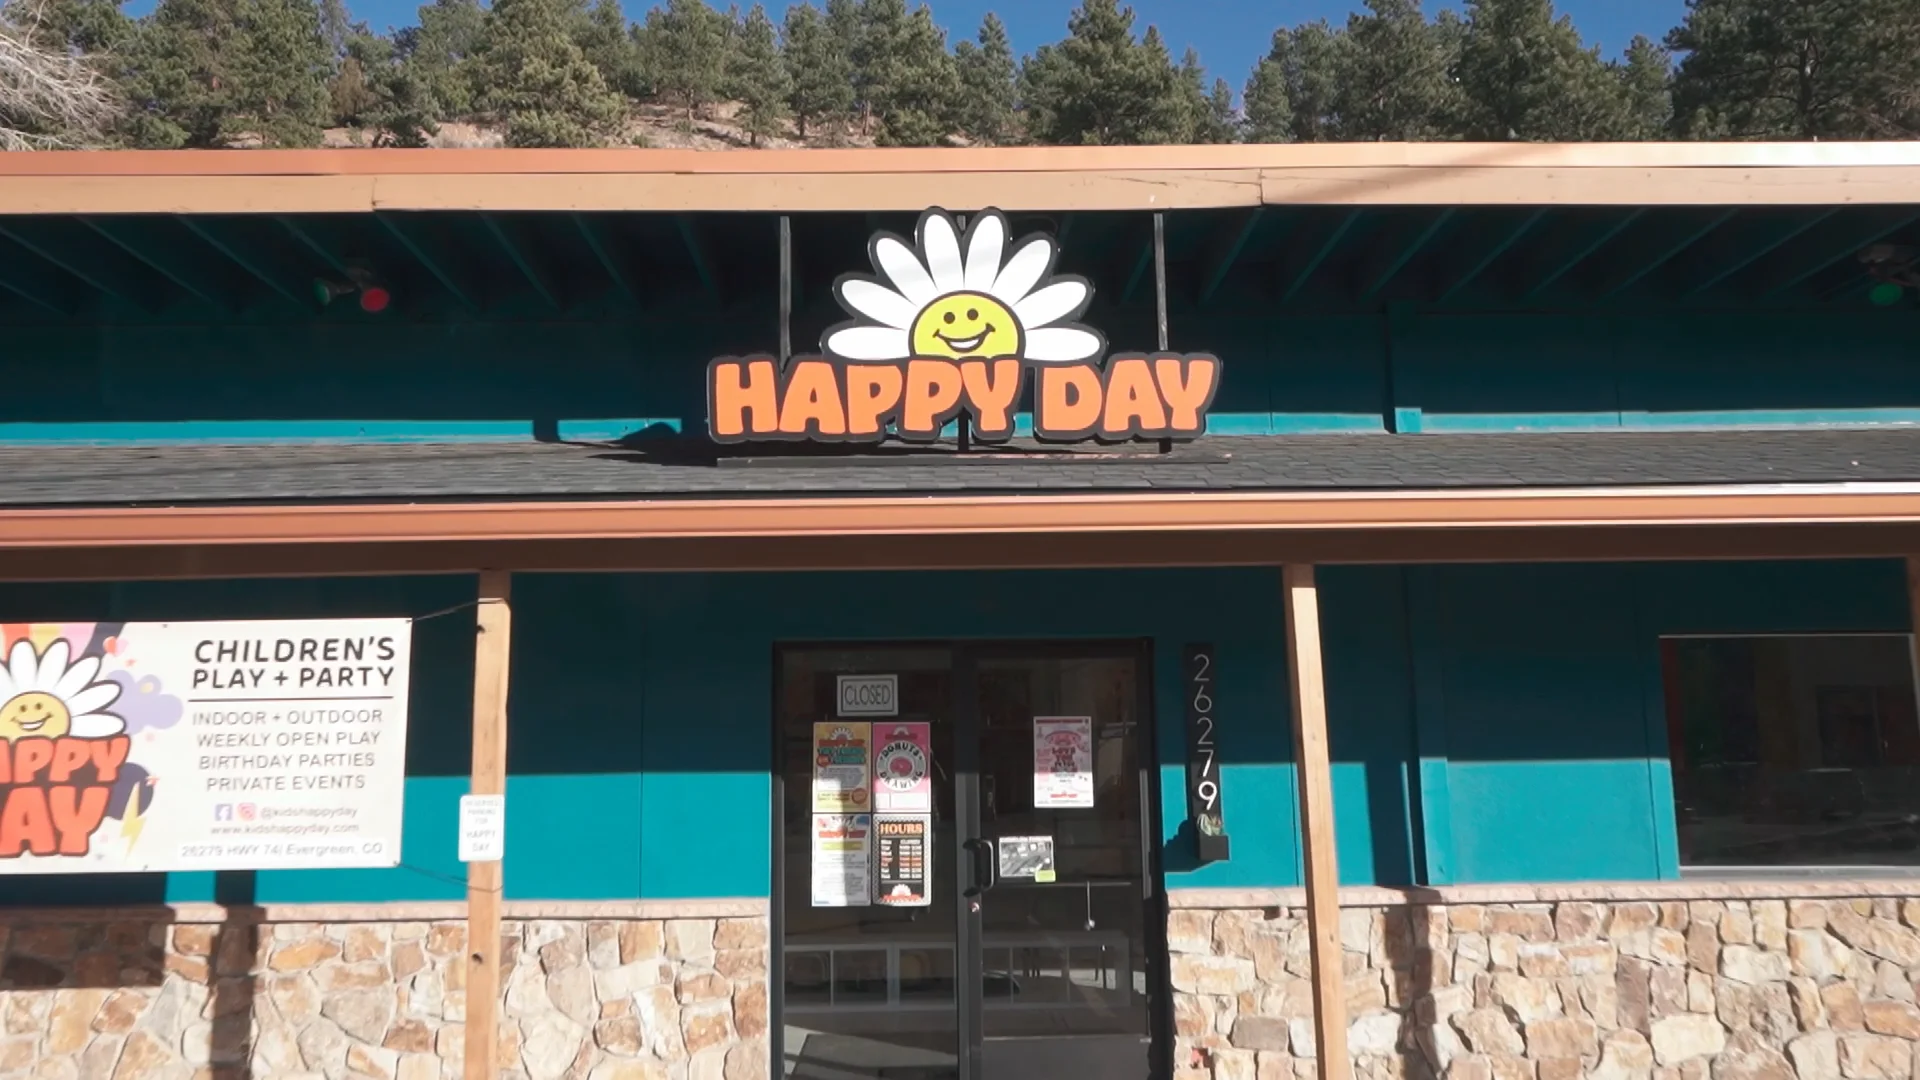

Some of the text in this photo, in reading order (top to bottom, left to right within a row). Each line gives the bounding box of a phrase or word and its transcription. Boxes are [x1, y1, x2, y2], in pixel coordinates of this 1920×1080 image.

[715, 358, 1215, 436] HAPPY DAY
[195, 636, 396, 664] CHILDREN'S
[192, 666, 395, 689] PLAY + PARTY
[844, 684, 891, 705] CLOSED
[192, 710, 266, 726] INDOOR
[287, 709, 384, 725] OUTDOOR
[197, 730, 382, 748] WEEKLY OPEN PLAY
[1193, 653, 1218, 811] 26279
[881, 742, 920, 758] DONUTS
[199, 752, 375, 770] BIRTHDAY PARTIES
[206, 774, 366, 792] PRIVATE EVENTS
[880, 823, 923, 835] HOURS
